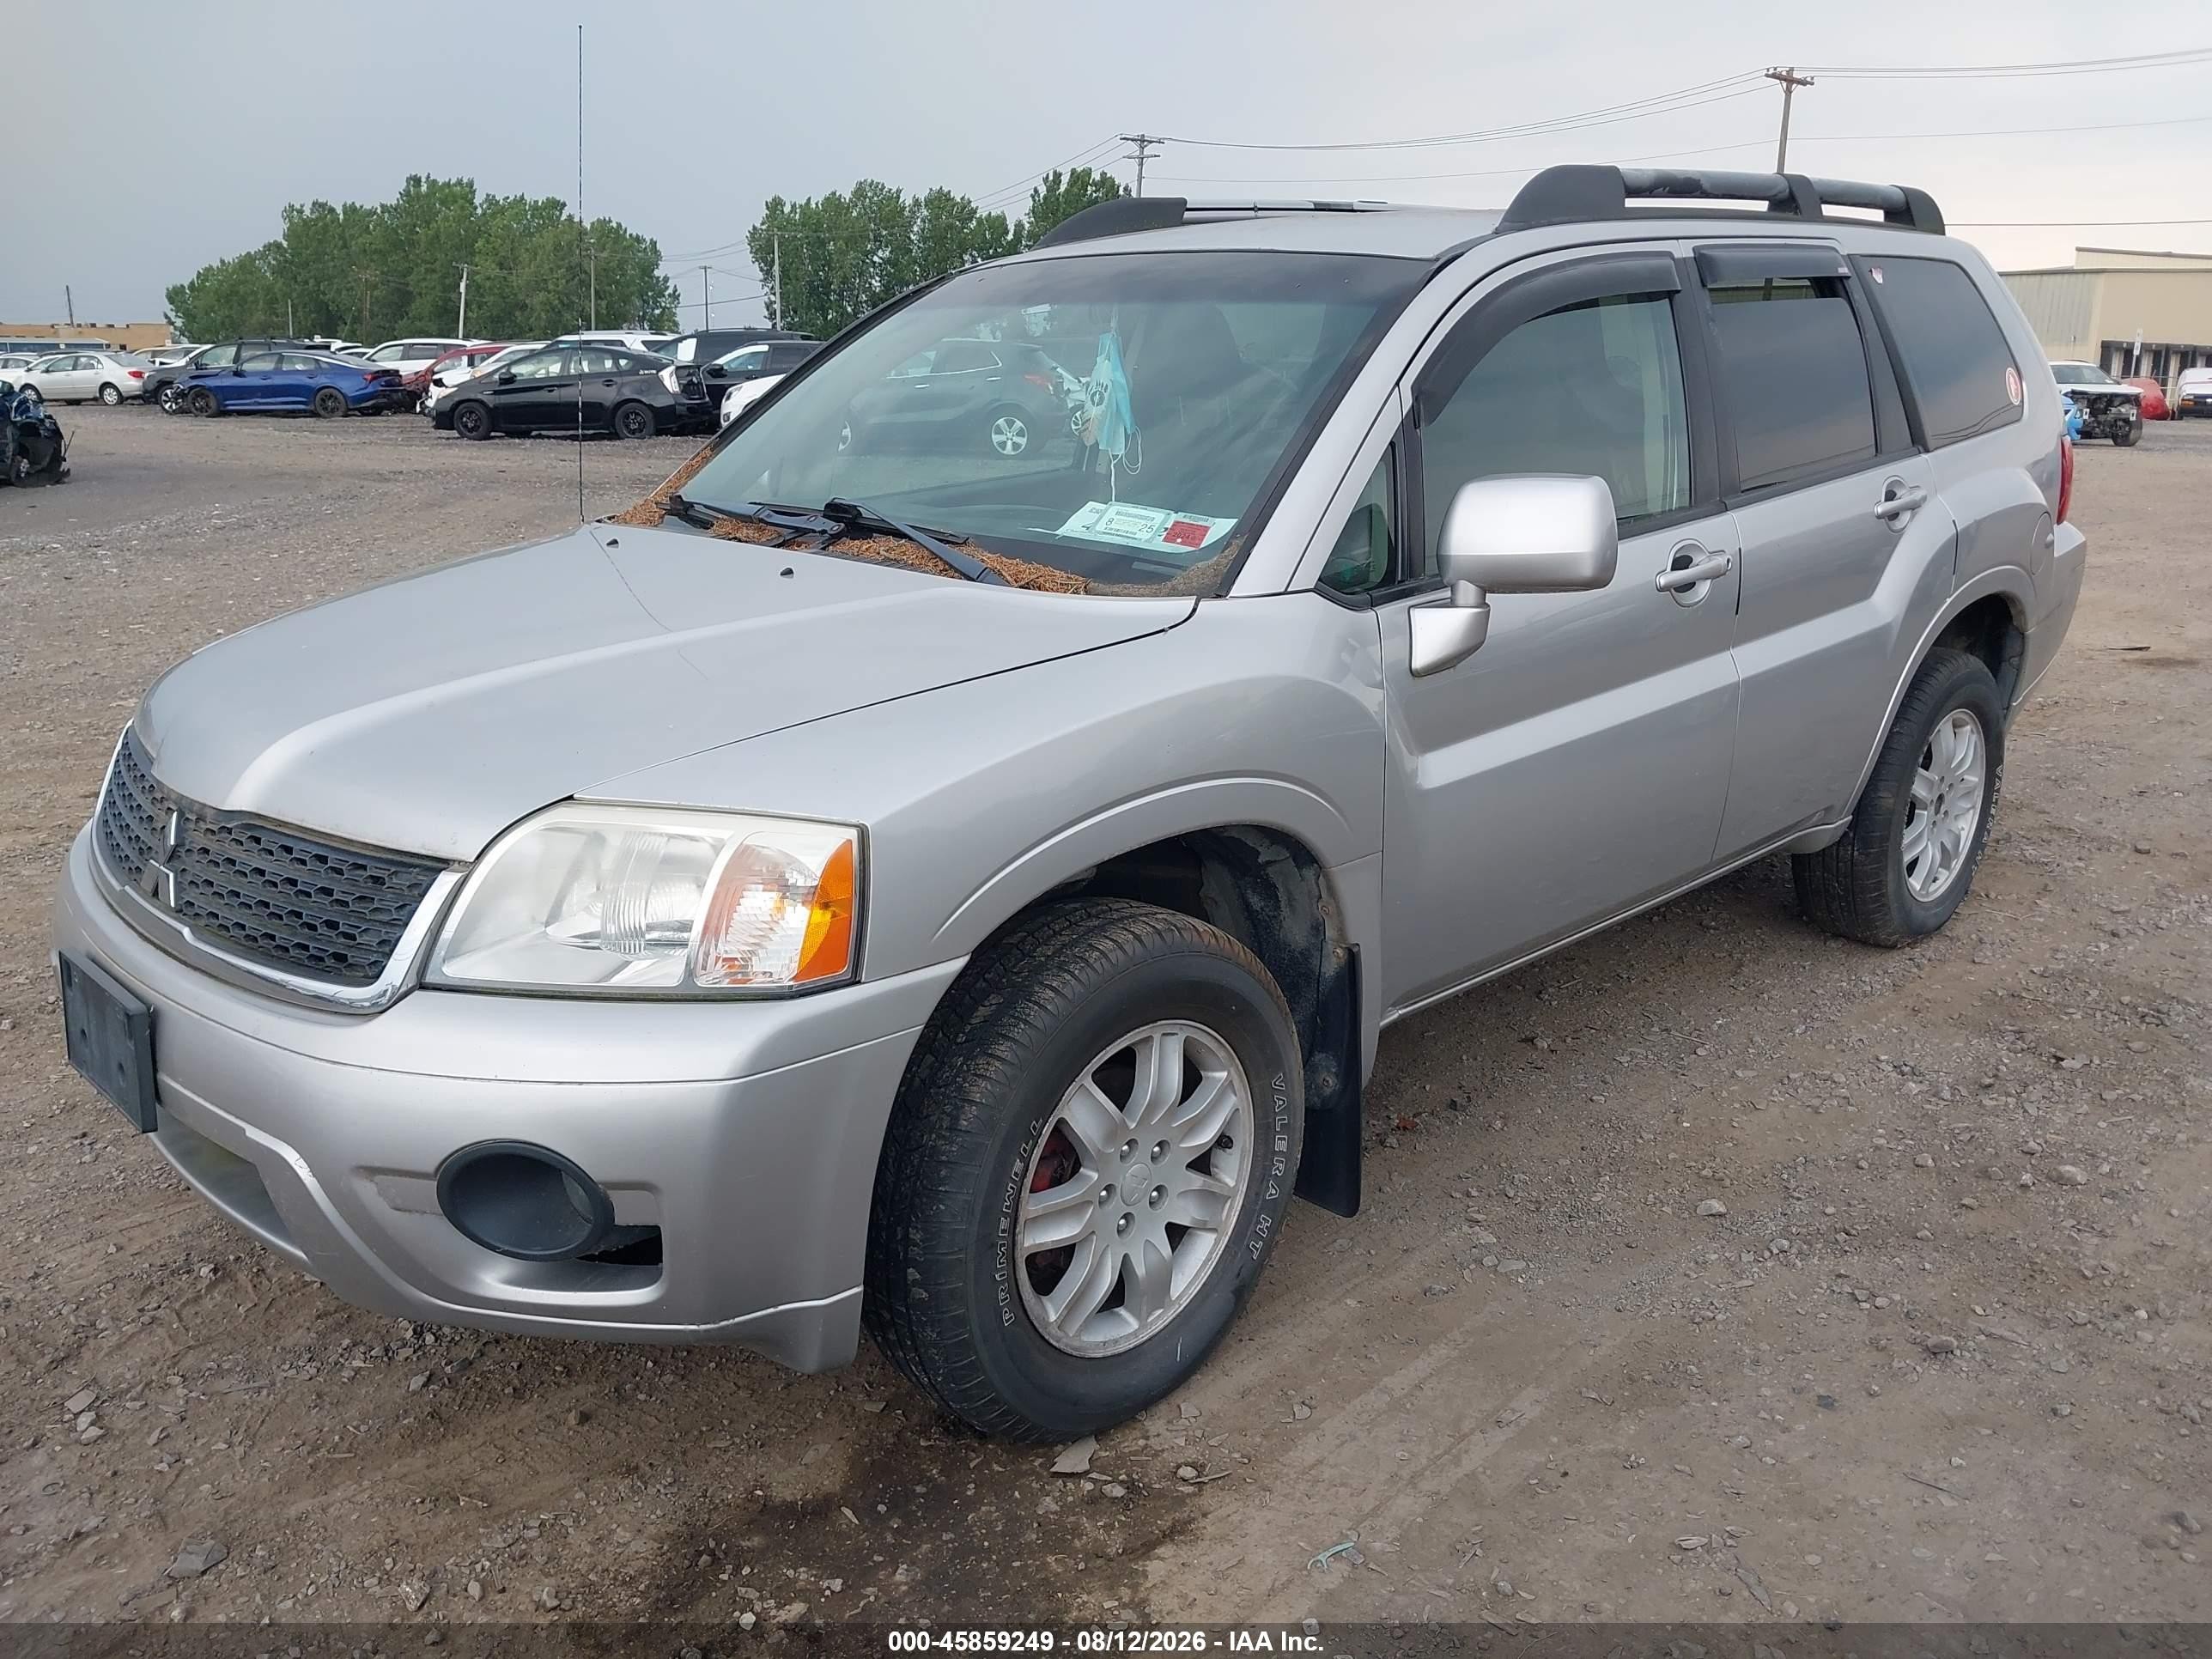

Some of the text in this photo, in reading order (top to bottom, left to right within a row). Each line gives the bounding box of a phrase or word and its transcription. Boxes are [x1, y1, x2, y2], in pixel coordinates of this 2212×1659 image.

[1104, 517, 1115, 526] 8
[1138, 523, 1157, 534] 25
[994, 1116, 1044, 1327] PRIMEWELL
[1249, 1073, 1288, 1261] VALERA HT
